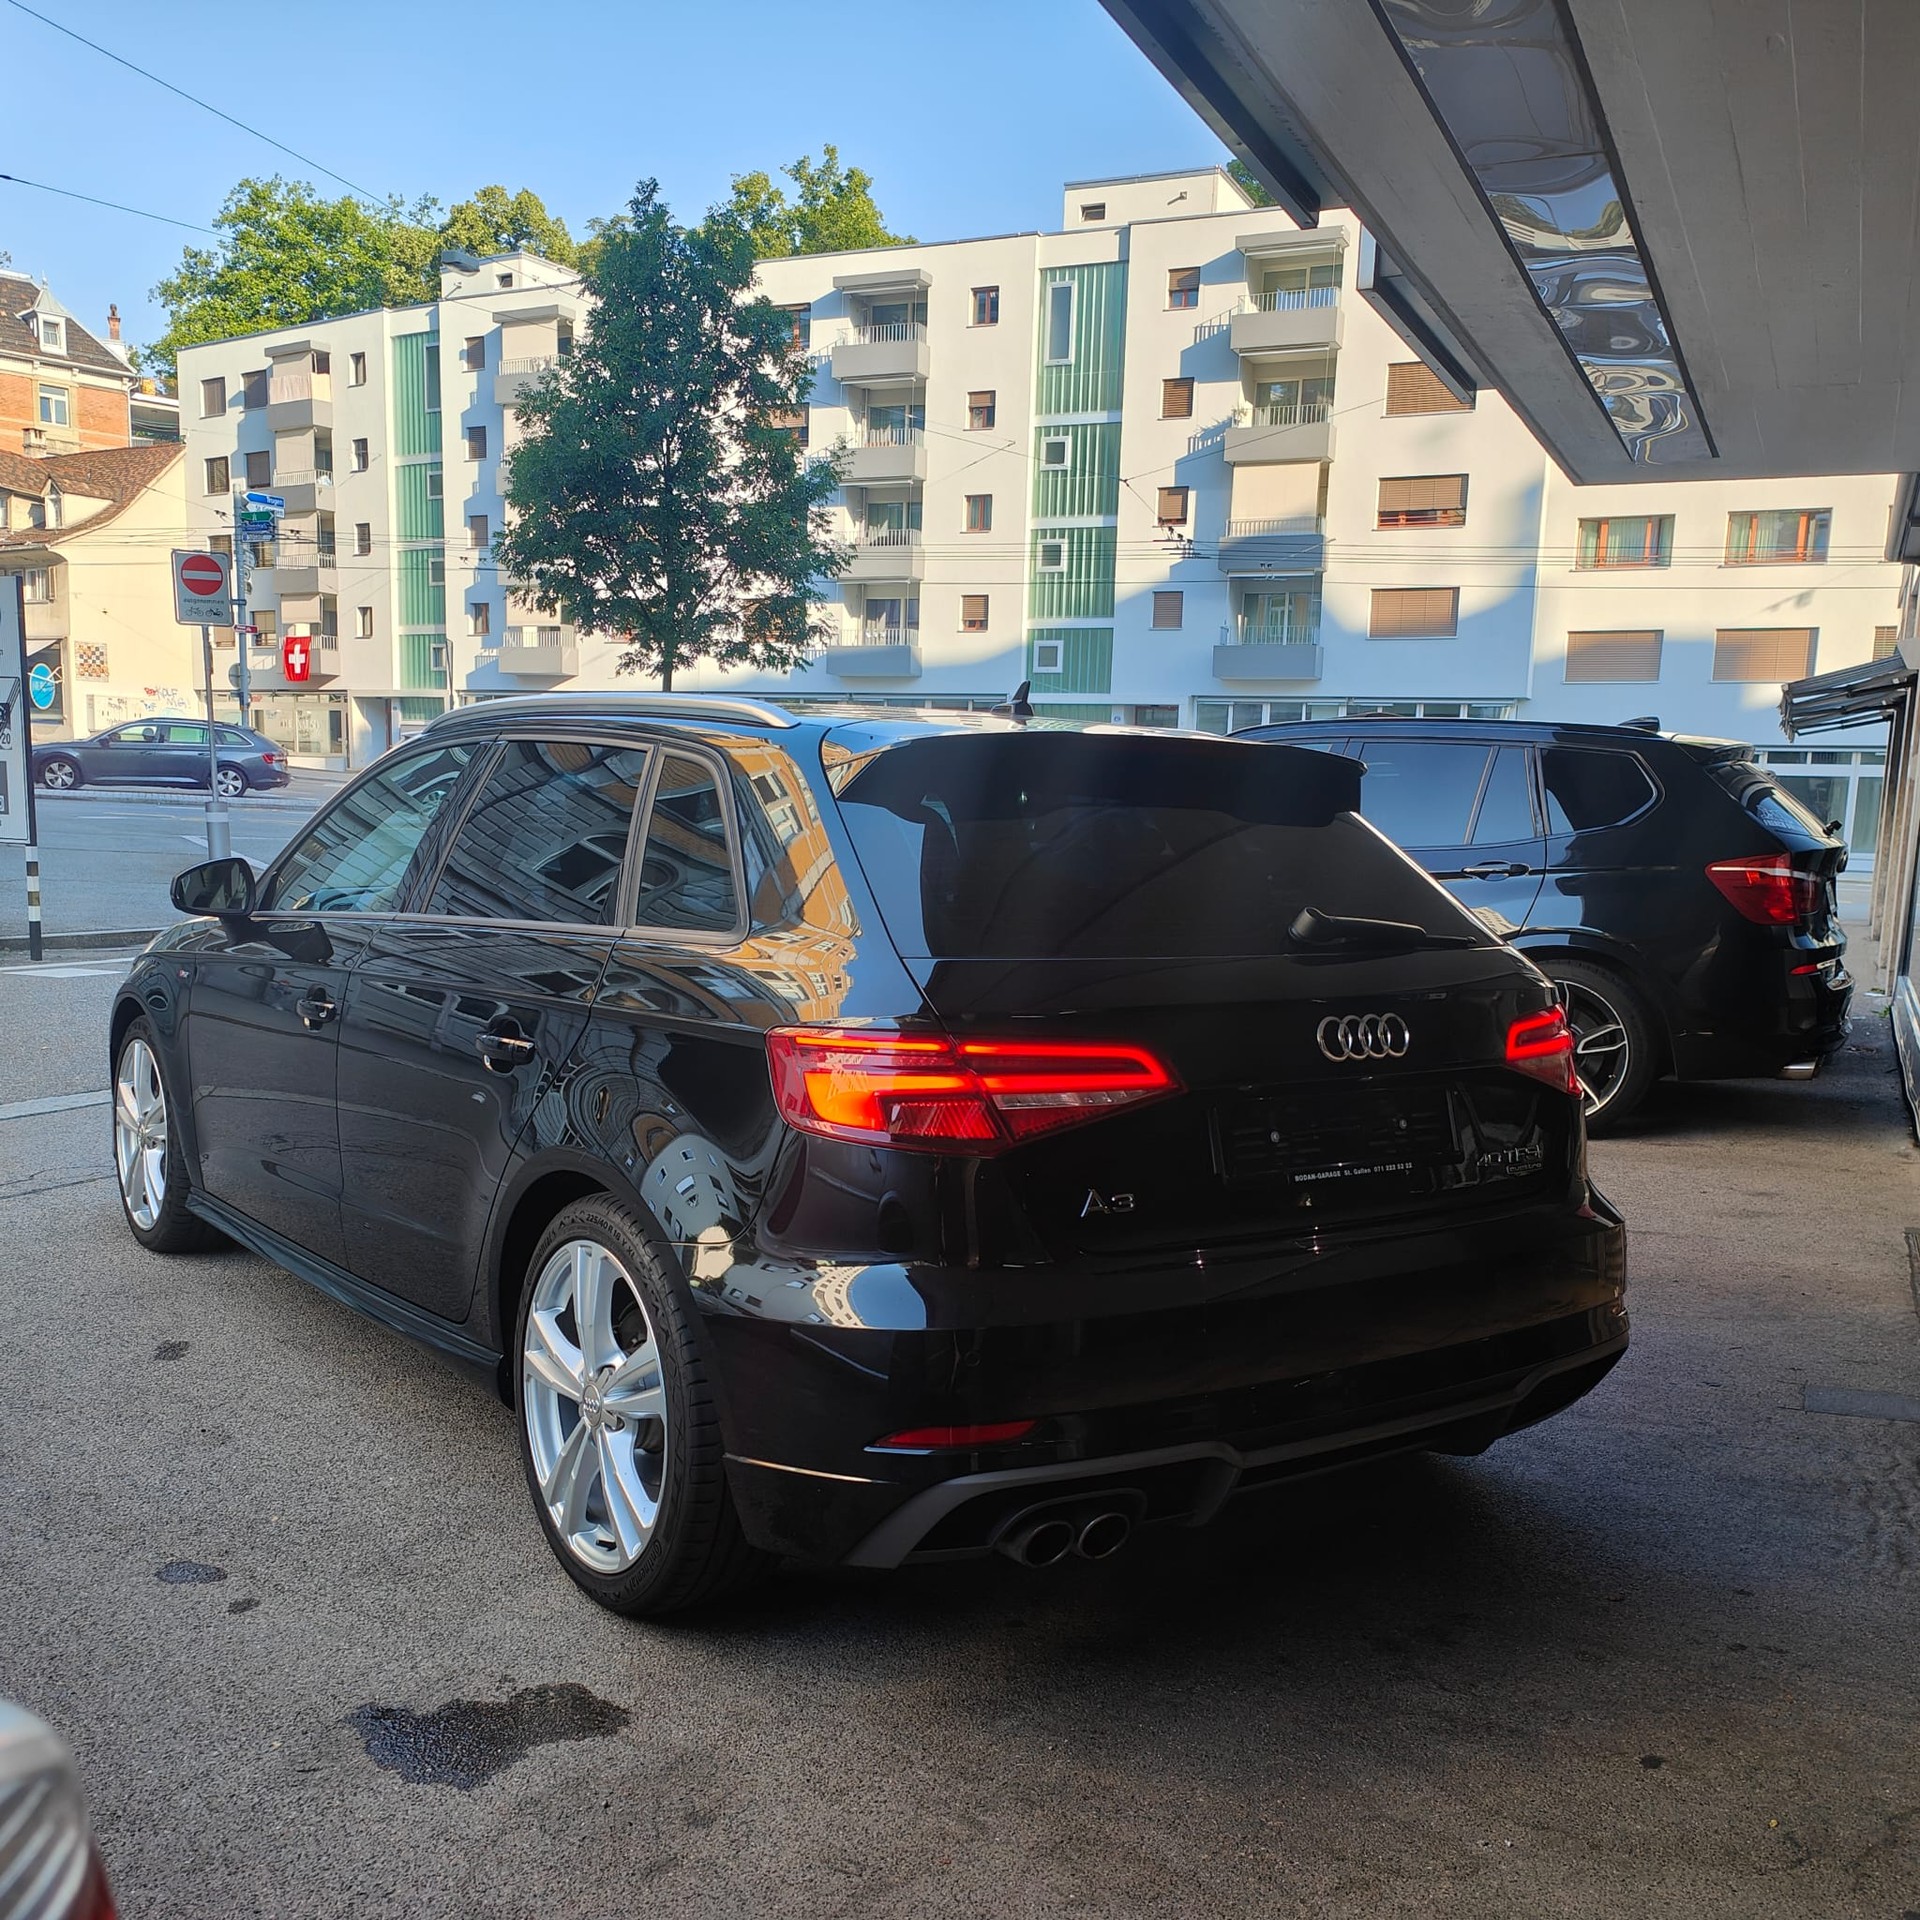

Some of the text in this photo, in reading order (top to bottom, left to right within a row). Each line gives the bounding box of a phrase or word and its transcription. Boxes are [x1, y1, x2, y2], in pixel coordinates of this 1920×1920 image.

[1294, 1170, 1341, 1182] BODAN-GARAGE
[1353, 1167, 1371, 1175] Gallen
[1080, 1187, 1134, 1217] A3
[586, 1213, 609, 1229] 225/40
